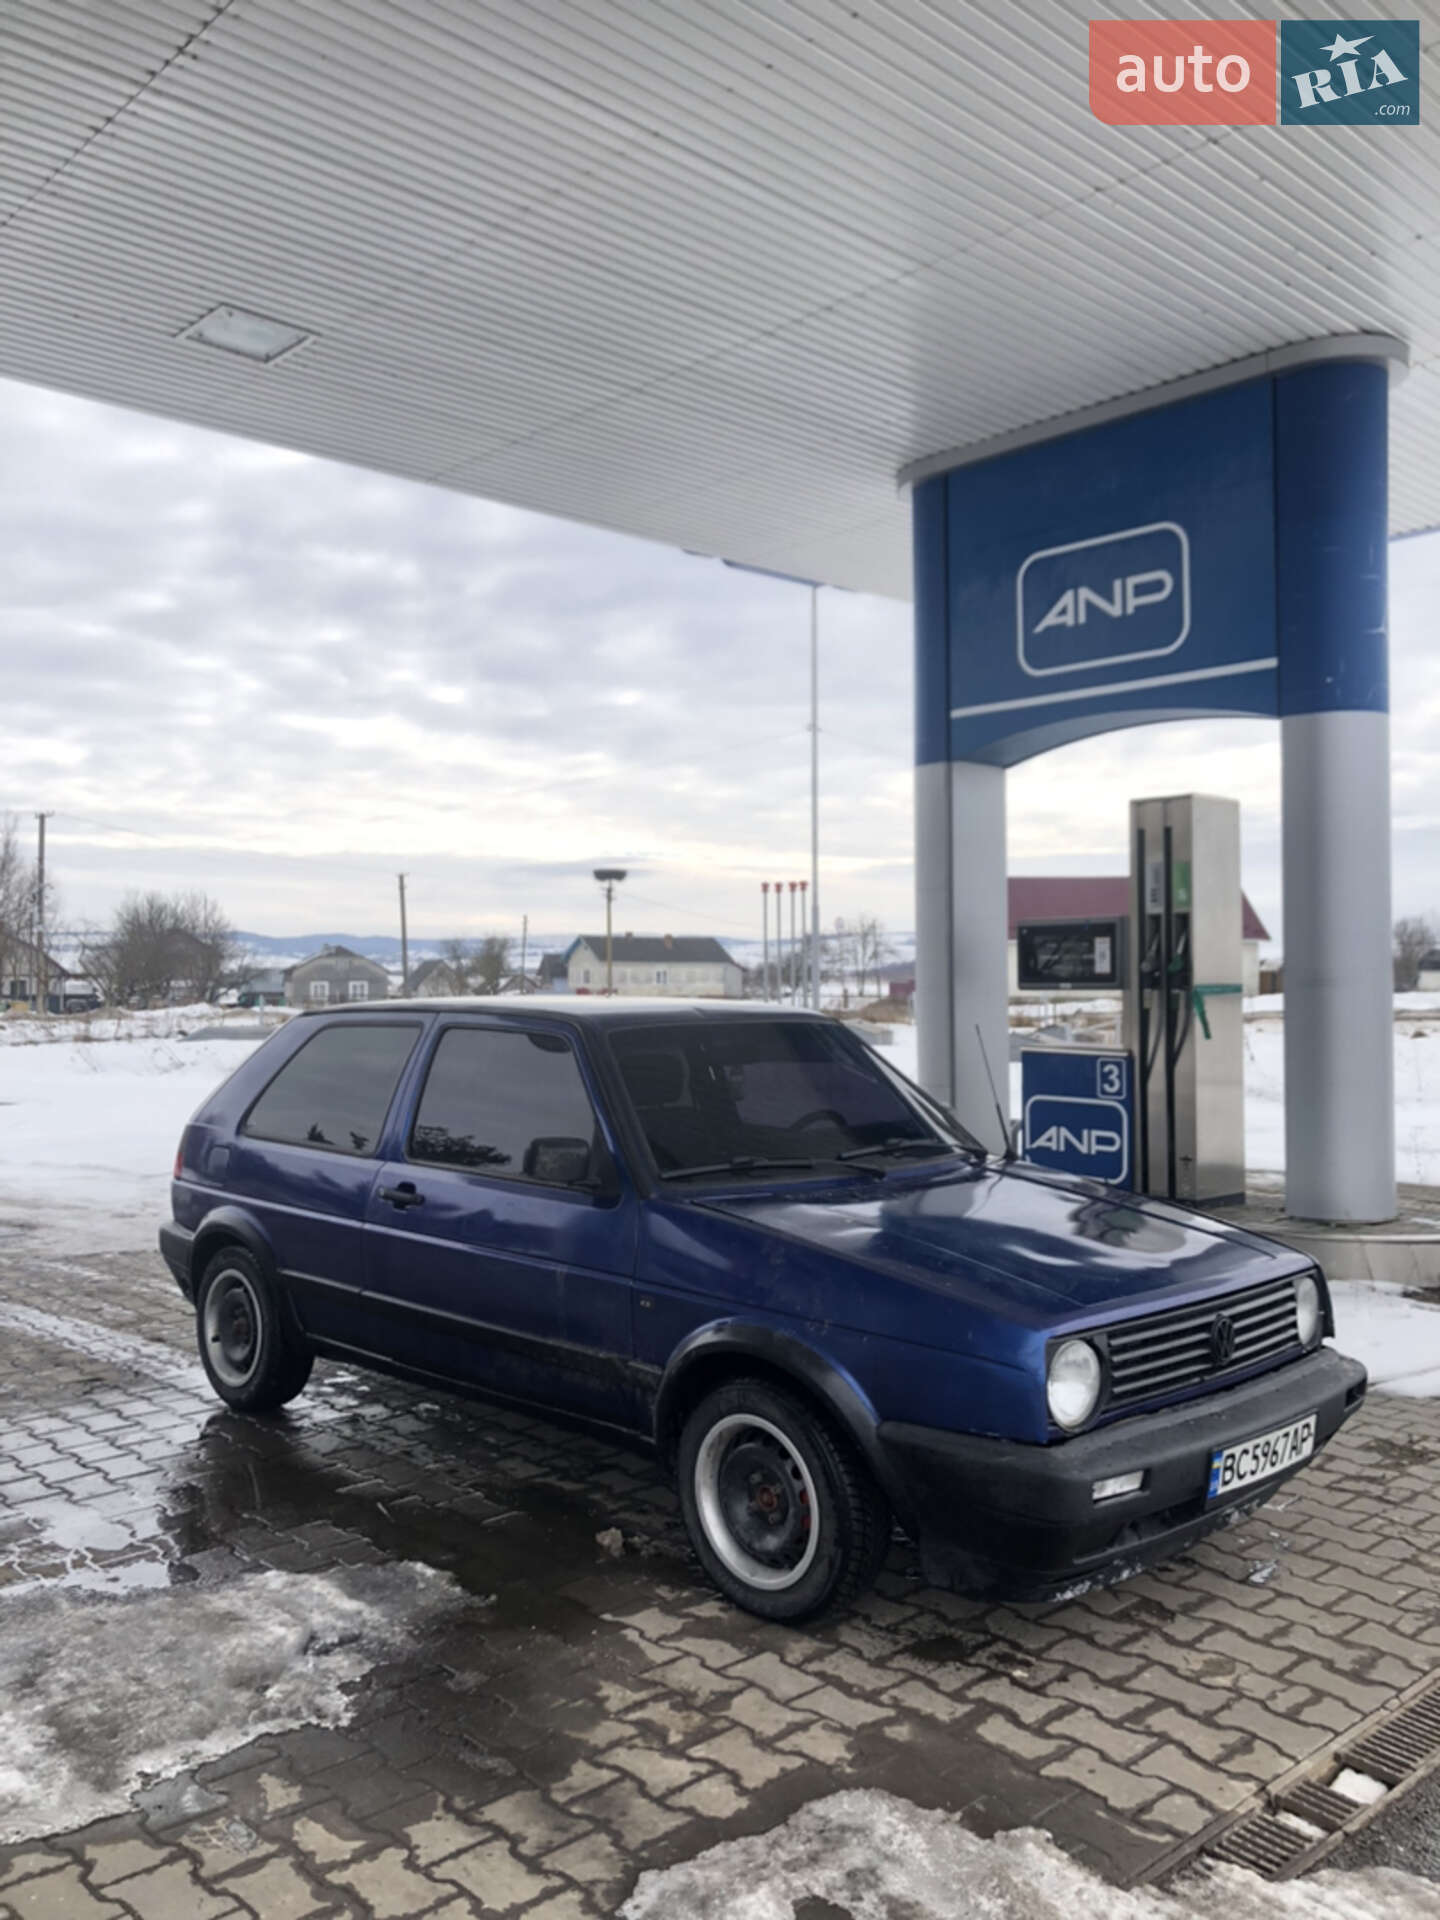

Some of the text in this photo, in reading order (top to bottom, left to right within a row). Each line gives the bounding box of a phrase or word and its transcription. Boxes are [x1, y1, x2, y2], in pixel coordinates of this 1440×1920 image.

[1032, 569, 1174, 634] ANP
[1102, 1064, 1121, 1093] 3
[1031, 1125, 1122, 1155] ANP
